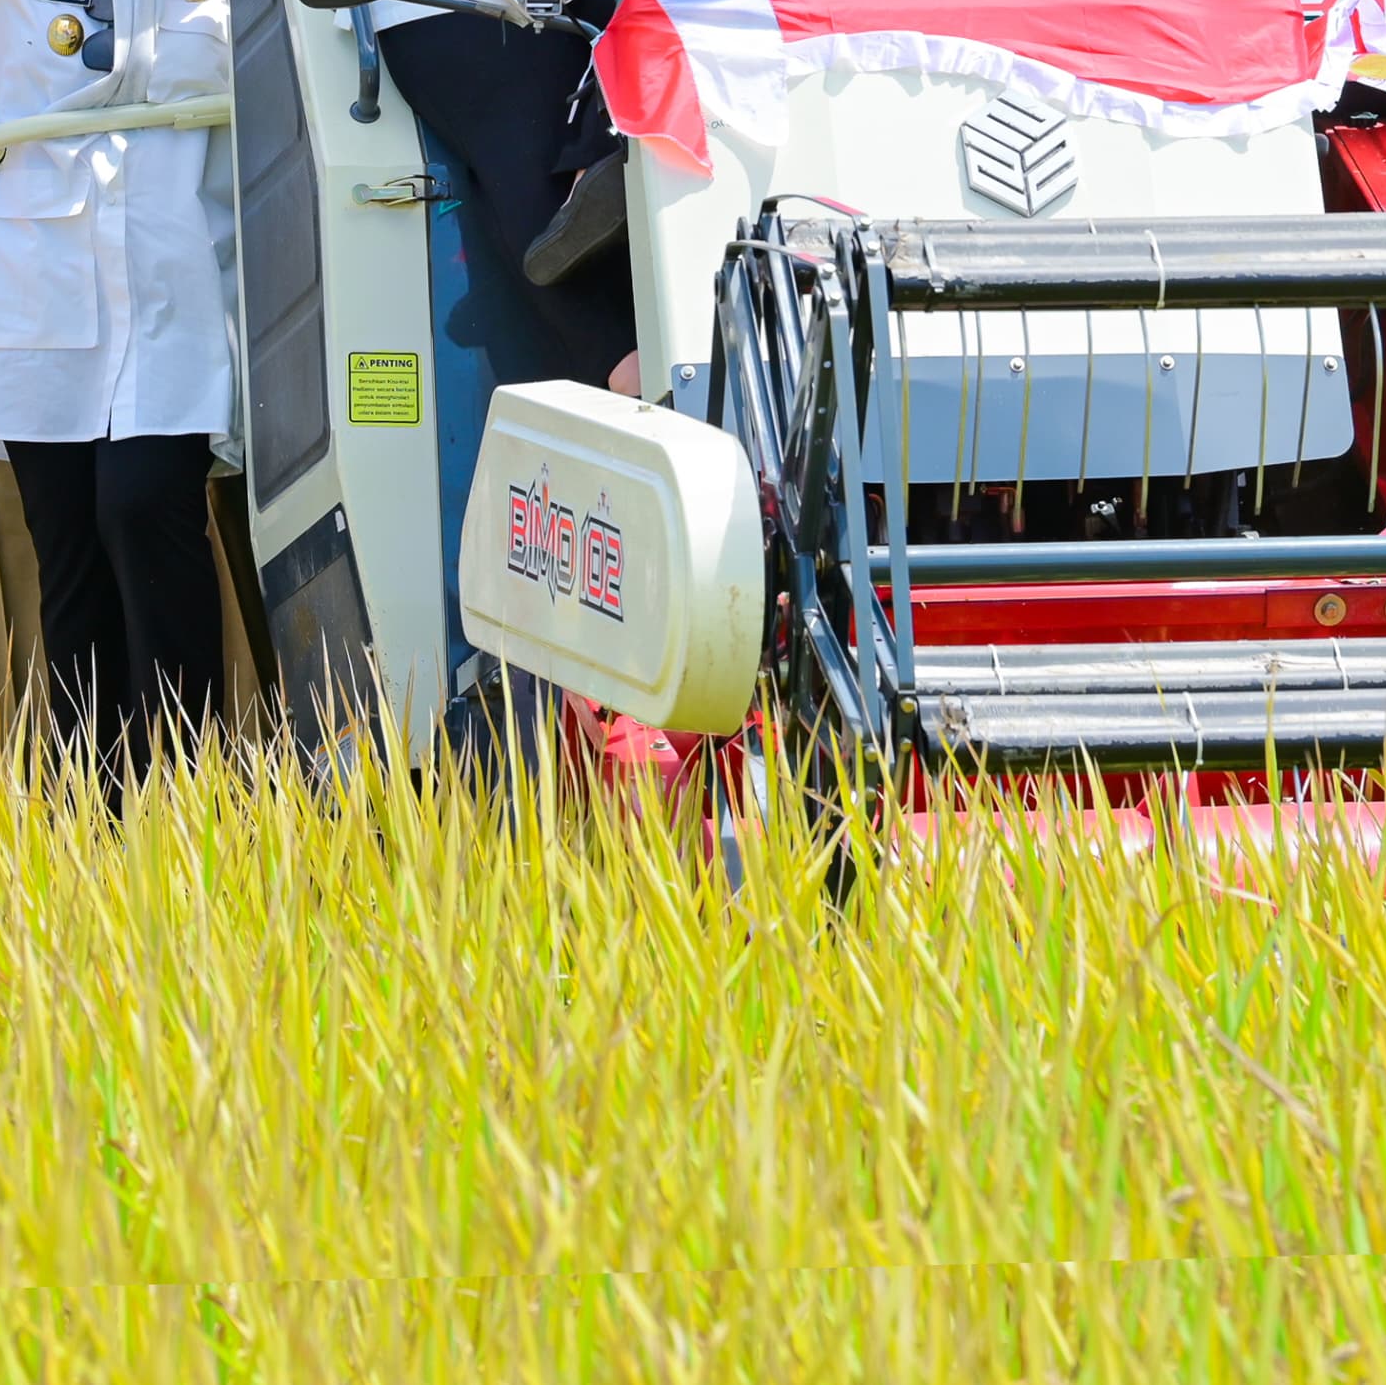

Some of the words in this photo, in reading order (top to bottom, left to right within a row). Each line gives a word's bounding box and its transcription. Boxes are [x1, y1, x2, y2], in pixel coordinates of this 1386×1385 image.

[370, 359, 413, 368] PENTING
[508, 479, 578, 606] BIMO
[579, 511, 625, 624] 102
